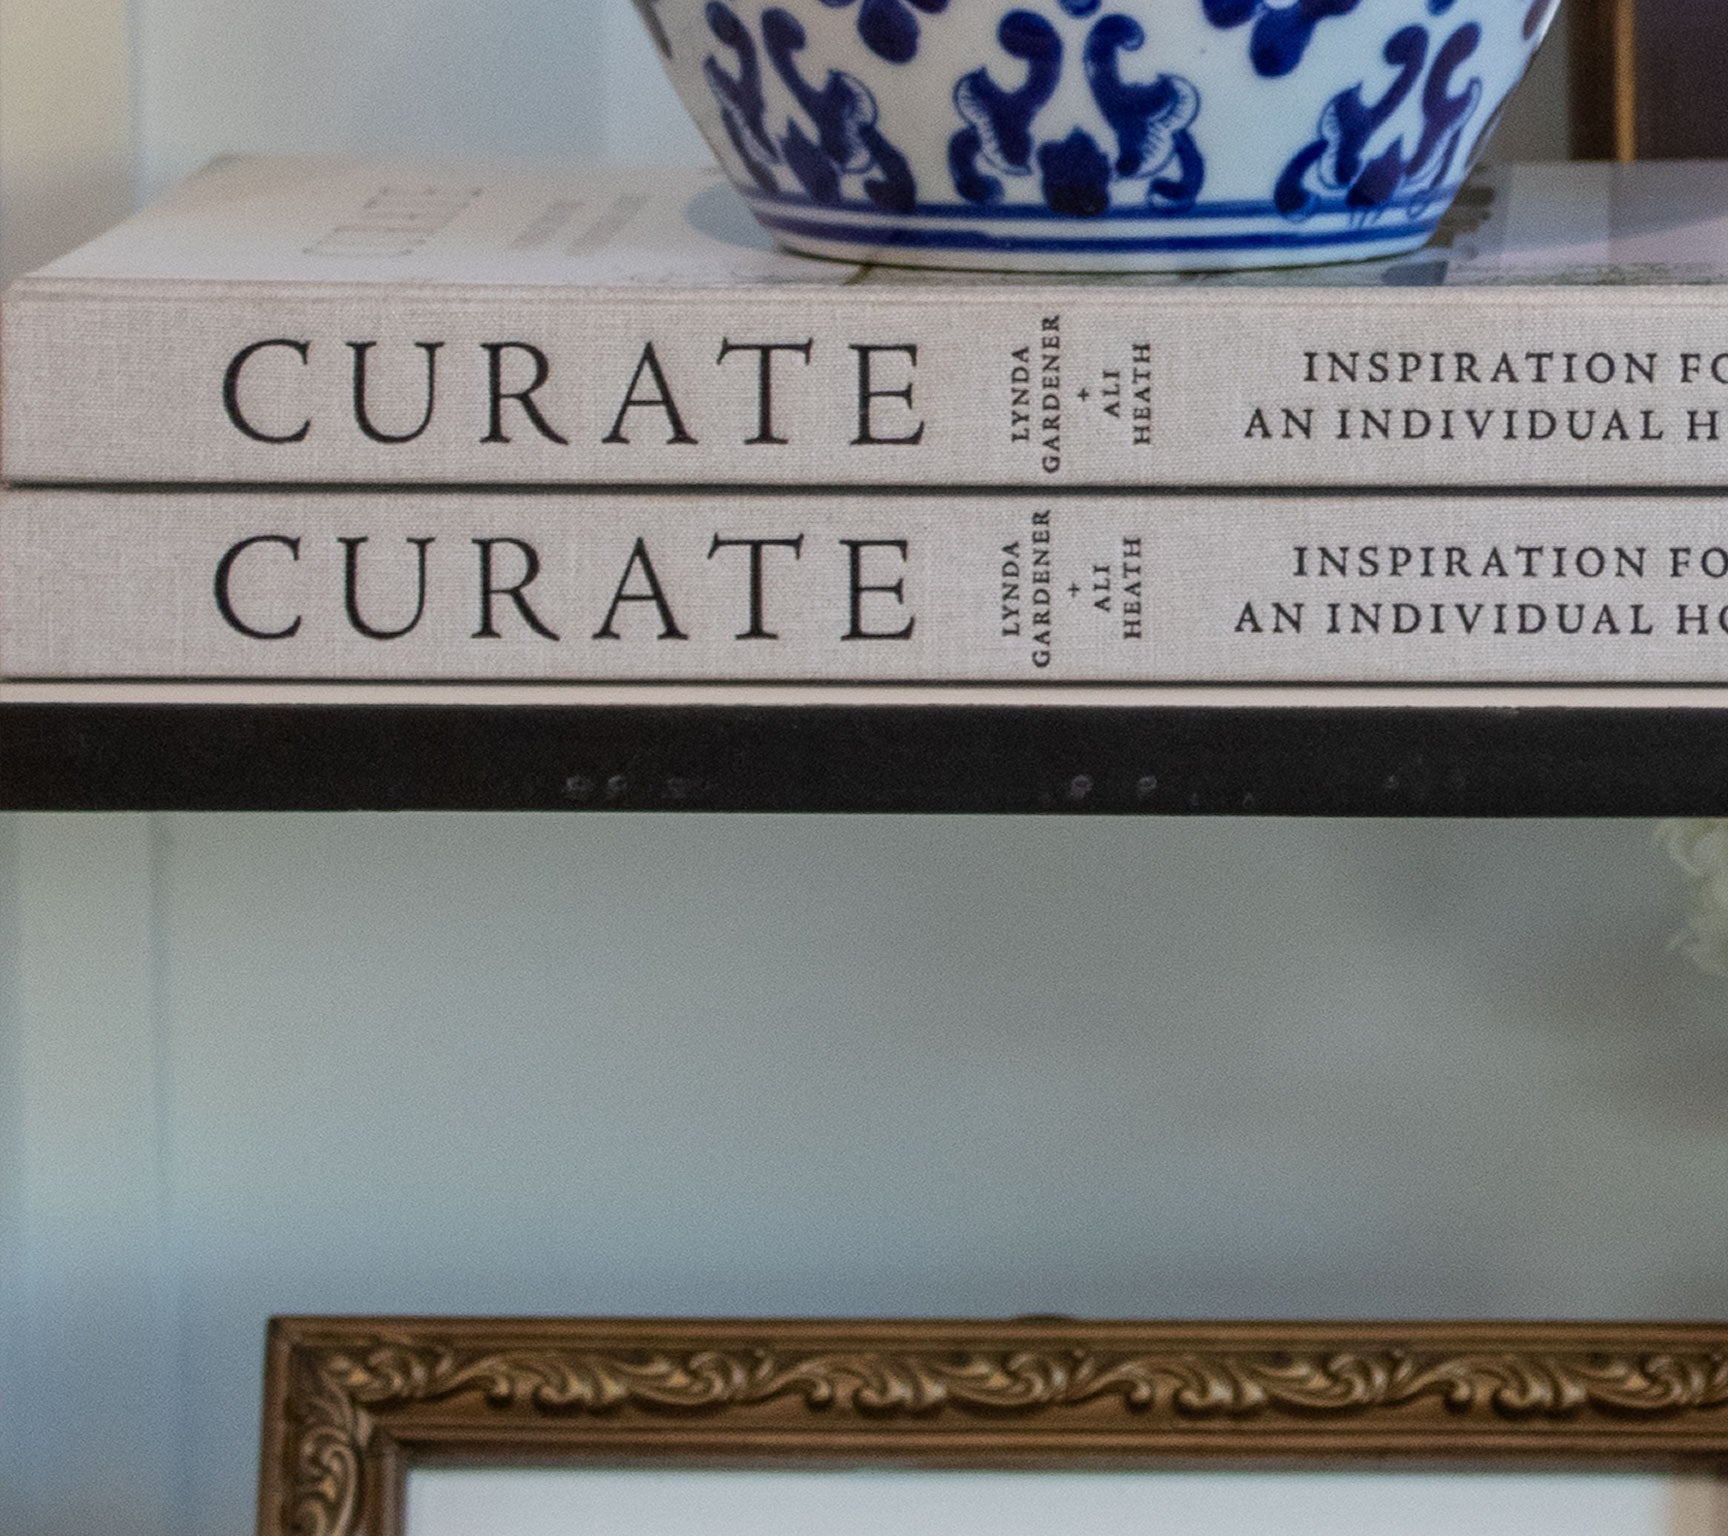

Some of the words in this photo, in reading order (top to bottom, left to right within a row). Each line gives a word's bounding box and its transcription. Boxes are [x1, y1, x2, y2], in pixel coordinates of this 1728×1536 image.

[221, 337, 925, 446] CURATE
[1010, 345, 1031, 443] LYNDA
[1041, 314, 1061, 475] GARDENER
[1101, 369, 1121, 419] ALI
[1131, 342, 1153, 445] HEATH
[1303, 350, 1658, 385] INSPIRATION
[1244, 407, 1315, 440] AN
[1336, 407, 1664, 442] INDIVIDUAL
[213, 533, 916, 642] CURATE
[1001, 540, 1021, 637] LYNDA
[1031, 509, 1052, 669] GARDENER
[1092, 564, 1112, 613] ALI
[1122, 536, 1143, 640] HEATH
[1293, 545, 1647, 578] INSPIRATION
[1234, 601, 1305, 634] AN
[1326, 602, 1654, 636] INDIVIDUAL
